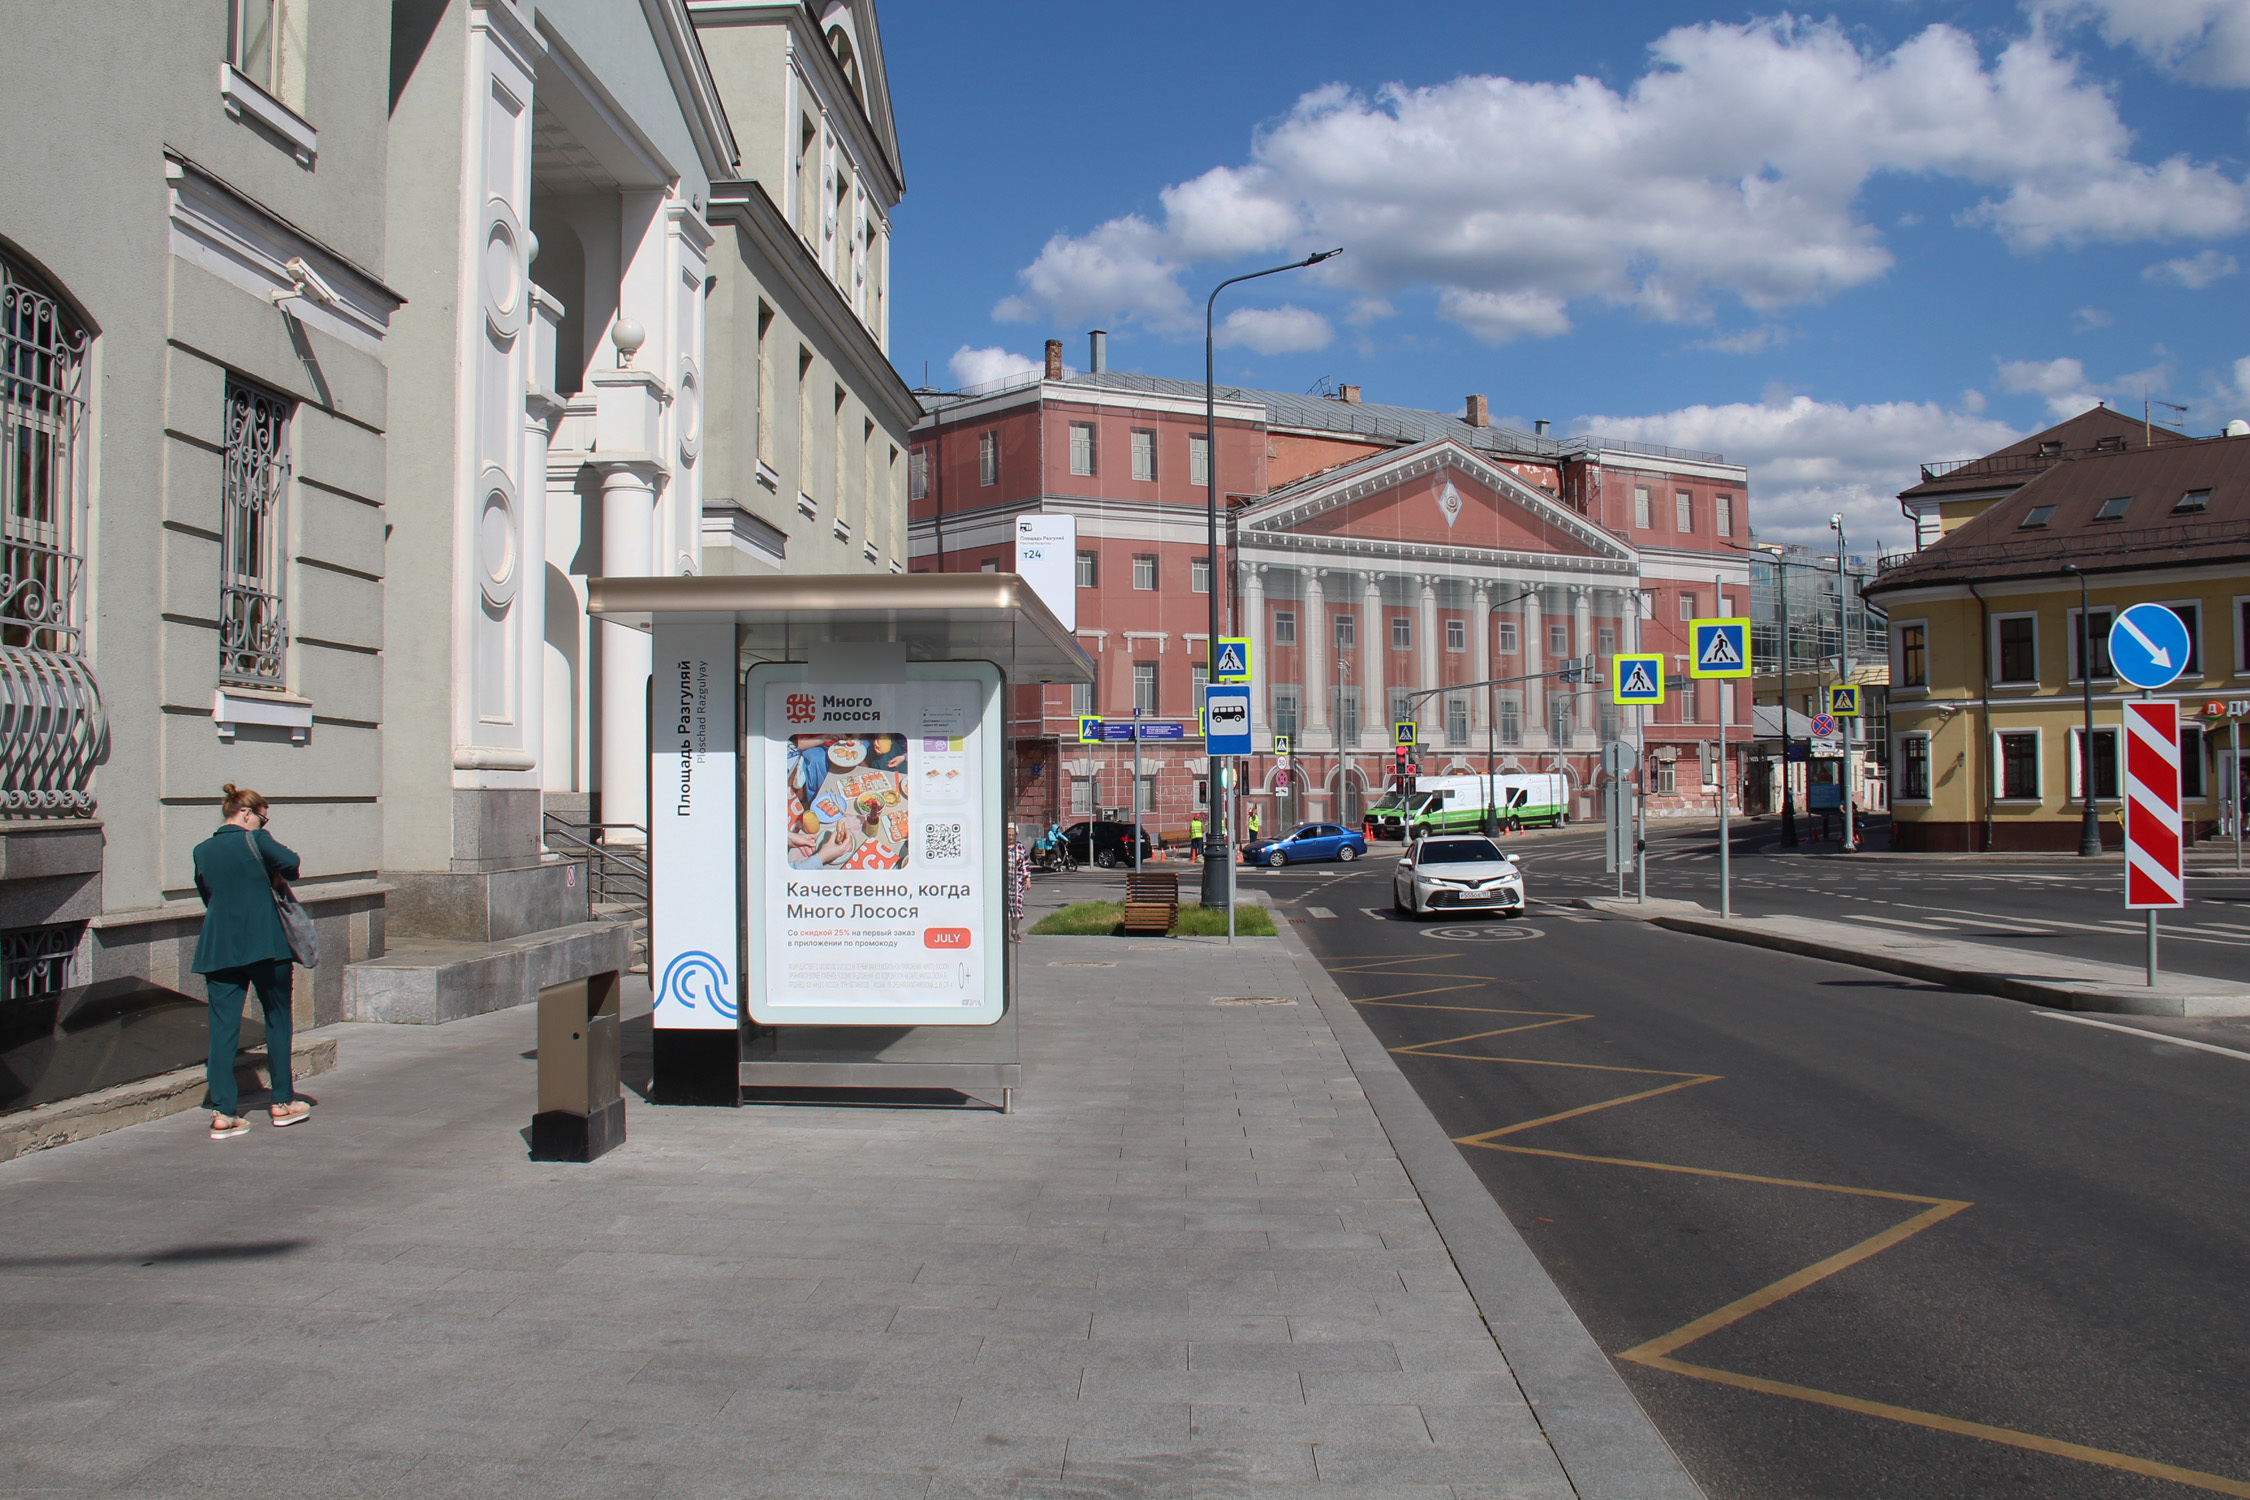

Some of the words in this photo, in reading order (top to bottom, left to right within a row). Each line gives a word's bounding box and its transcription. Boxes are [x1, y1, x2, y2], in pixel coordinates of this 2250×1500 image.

[697, 661, 708, 713] Razgulyay
[677, 661, 693, 734] Разгуляй
[822, 695, 873, 707] Много
[822, 711, 880, 721] лосося
[697, 717, 706, 764] Ploschad
[677, 740, 692, 816] Площадь
[787, 882, 913, 899] Качественно,
[918, 884, 971, 899] когда
[787, 904, 845, 918] Много
[850, 904, 919, 918] Лосося
[800, 929, 832, 938] скидкой
[862, 929, 892, 938] первый
[934, 934, 961, 943] JULY
[794, 940, 842, 948] приложении
[854, 940, 898, 948] промокоду
